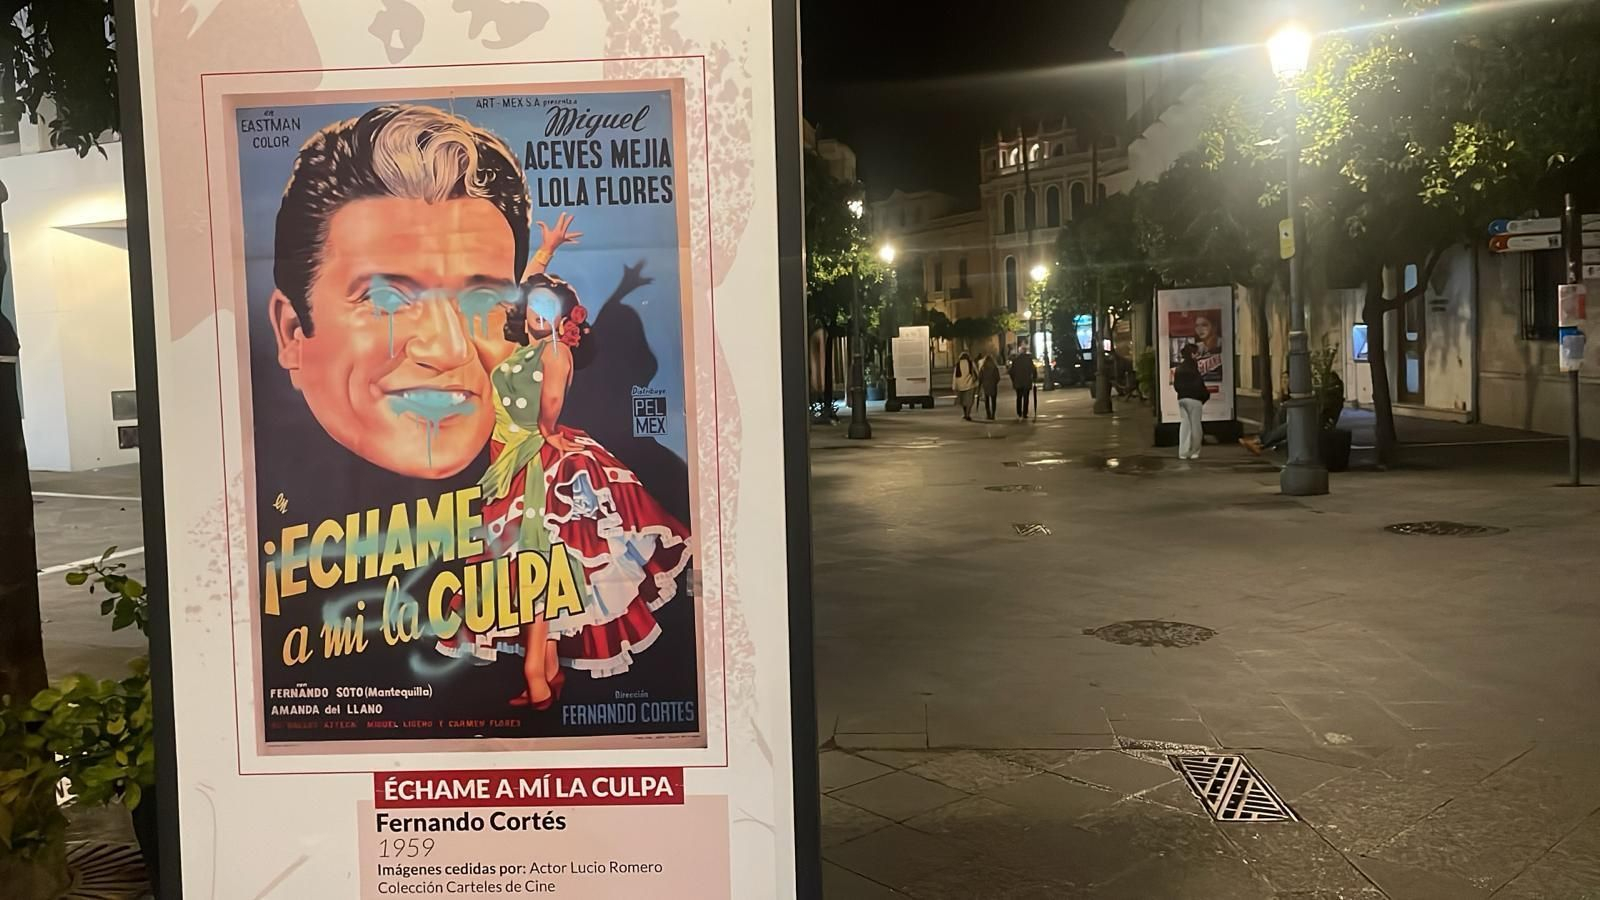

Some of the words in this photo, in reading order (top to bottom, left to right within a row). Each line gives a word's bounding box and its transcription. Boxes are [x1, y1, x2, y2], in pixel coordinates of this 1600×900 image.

[241, 117, 301, 132] EASTMAN
[544, 105, 650, 138] Miguel
[252, 136, 289, 149] COLOR
[524, 139, 603, 170] ACEVES
[610, 138, 672, 168] MEJIA
[538, 177, 589, 207] LOLA
[596, 175, 673, 205] FLORES
[635, 399, 665, 416] PEL
[636, 417, 666, 434] MEX
[263, 486, 485, 616] ¡ECHAME
[282, 625, 314, 666] a
[320, 601, 369, 658] mi
[380, 575, 425, 646] la
[427, 542, 586, 640] CULPA
[270, 688, 329, 698] FERNANDO
[271, 705, 320, 716] AMANDA
[324, 704, 341, 714] del
[347, 704, 383, 715] LLANO
[562, 702, 637, 725] FERNANDO
[641, 701, 695, 723] CORTES
[448, 720, 485, 728] CARMEN
[384, 776, 490, 801] ÉCHAME
[495, 778, 514, 799] A
[519, 773, 550, 798] MÍ
[555, 776, 587, 798] LA
[592, 776, 674, 798] CULPA
[376, 812, 484, 833] Fernando
[489, 810, 566, 832] Cortés
[378, 838, 435, 858] 1959
[377, 863, 442, 878] Imágenes
[444, 862, 496, 875] cedidas
[499, 864, 526, 877] por:
[529, 862, 567, 874] Actor
[571, 861, 606, 874] Lucio
[609, 861, 663, 873] Romero
[378, 881, 443, 894] Colección
[446, 880, 502, 893] Carteles
[505, 880, 521, 893] de
[525, 880, 556, 892] Cine
